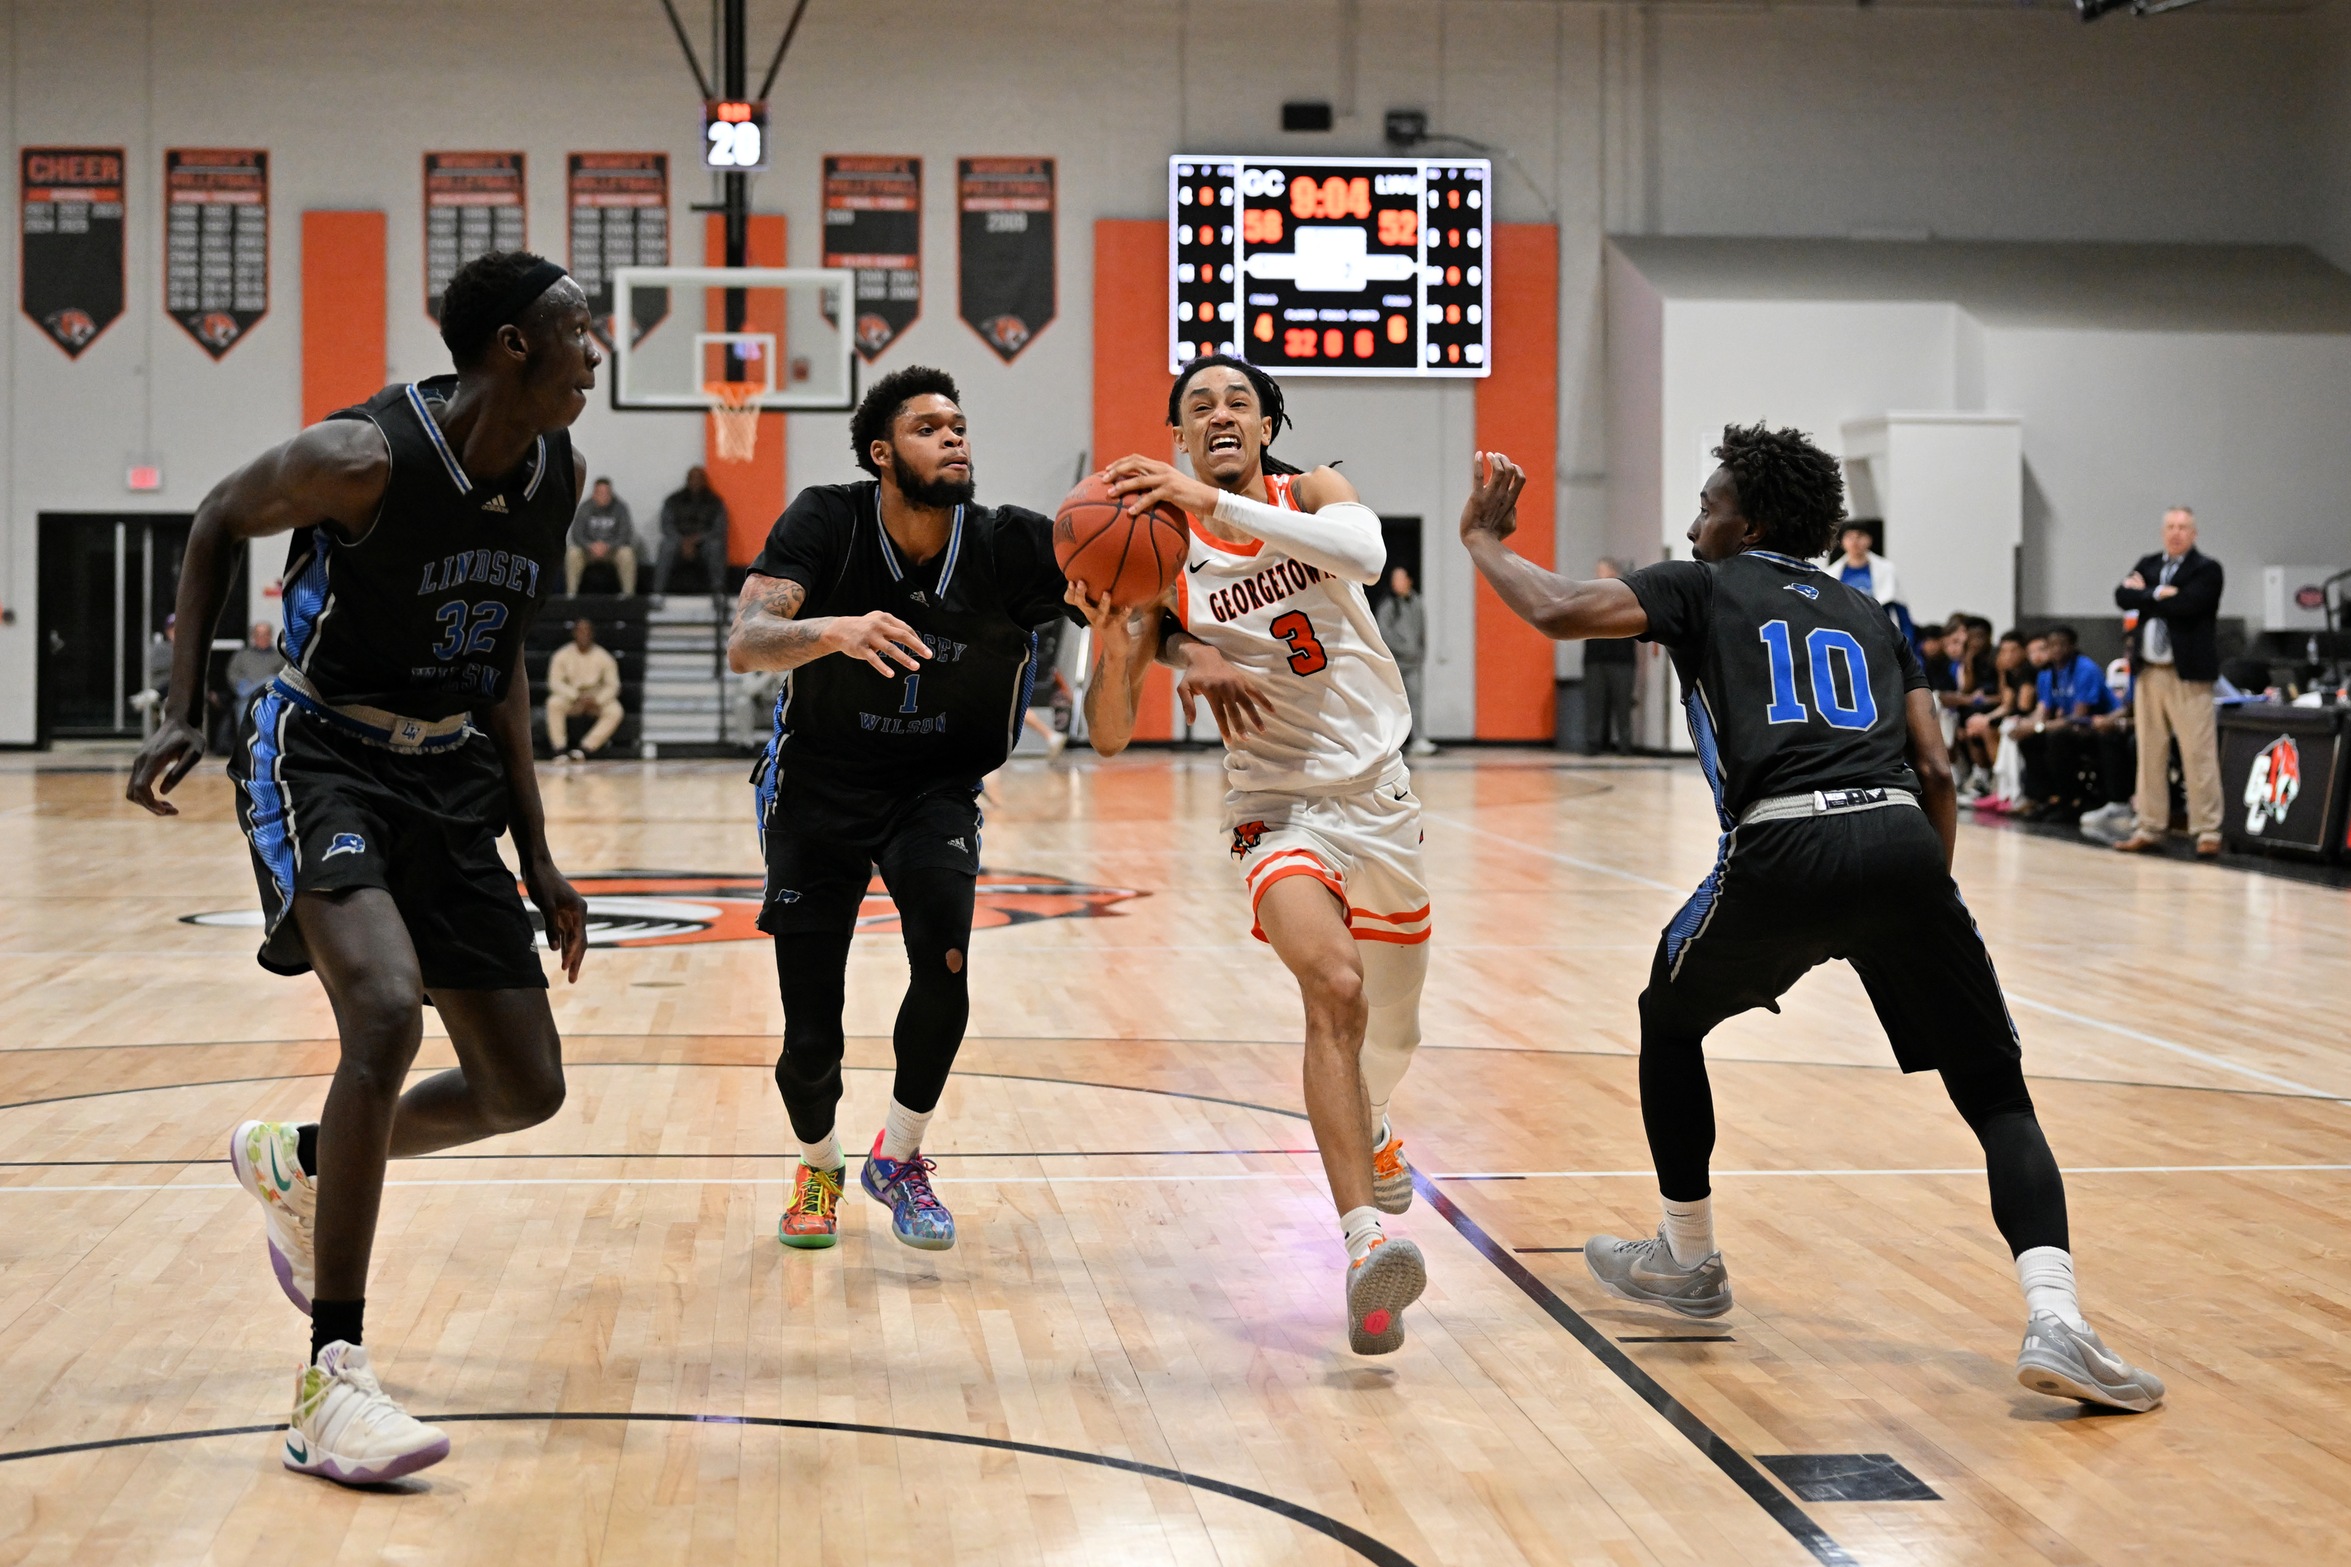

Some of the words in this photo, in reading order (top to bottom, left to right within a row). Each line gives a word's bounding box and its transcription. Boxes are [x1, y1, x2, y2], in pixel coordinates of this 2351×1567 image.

[417, 548, 541, 598] LINDSEY
[1209, 558, 1337, 623] GEORGETOW
[432, 599, 509, 661] 32
[1269, 609, 1328, 677] 3
[897, 673, 921, 714] 1
[1758, 619, 1878, 732] 10
[858, 711, 947, 735] WILSON
